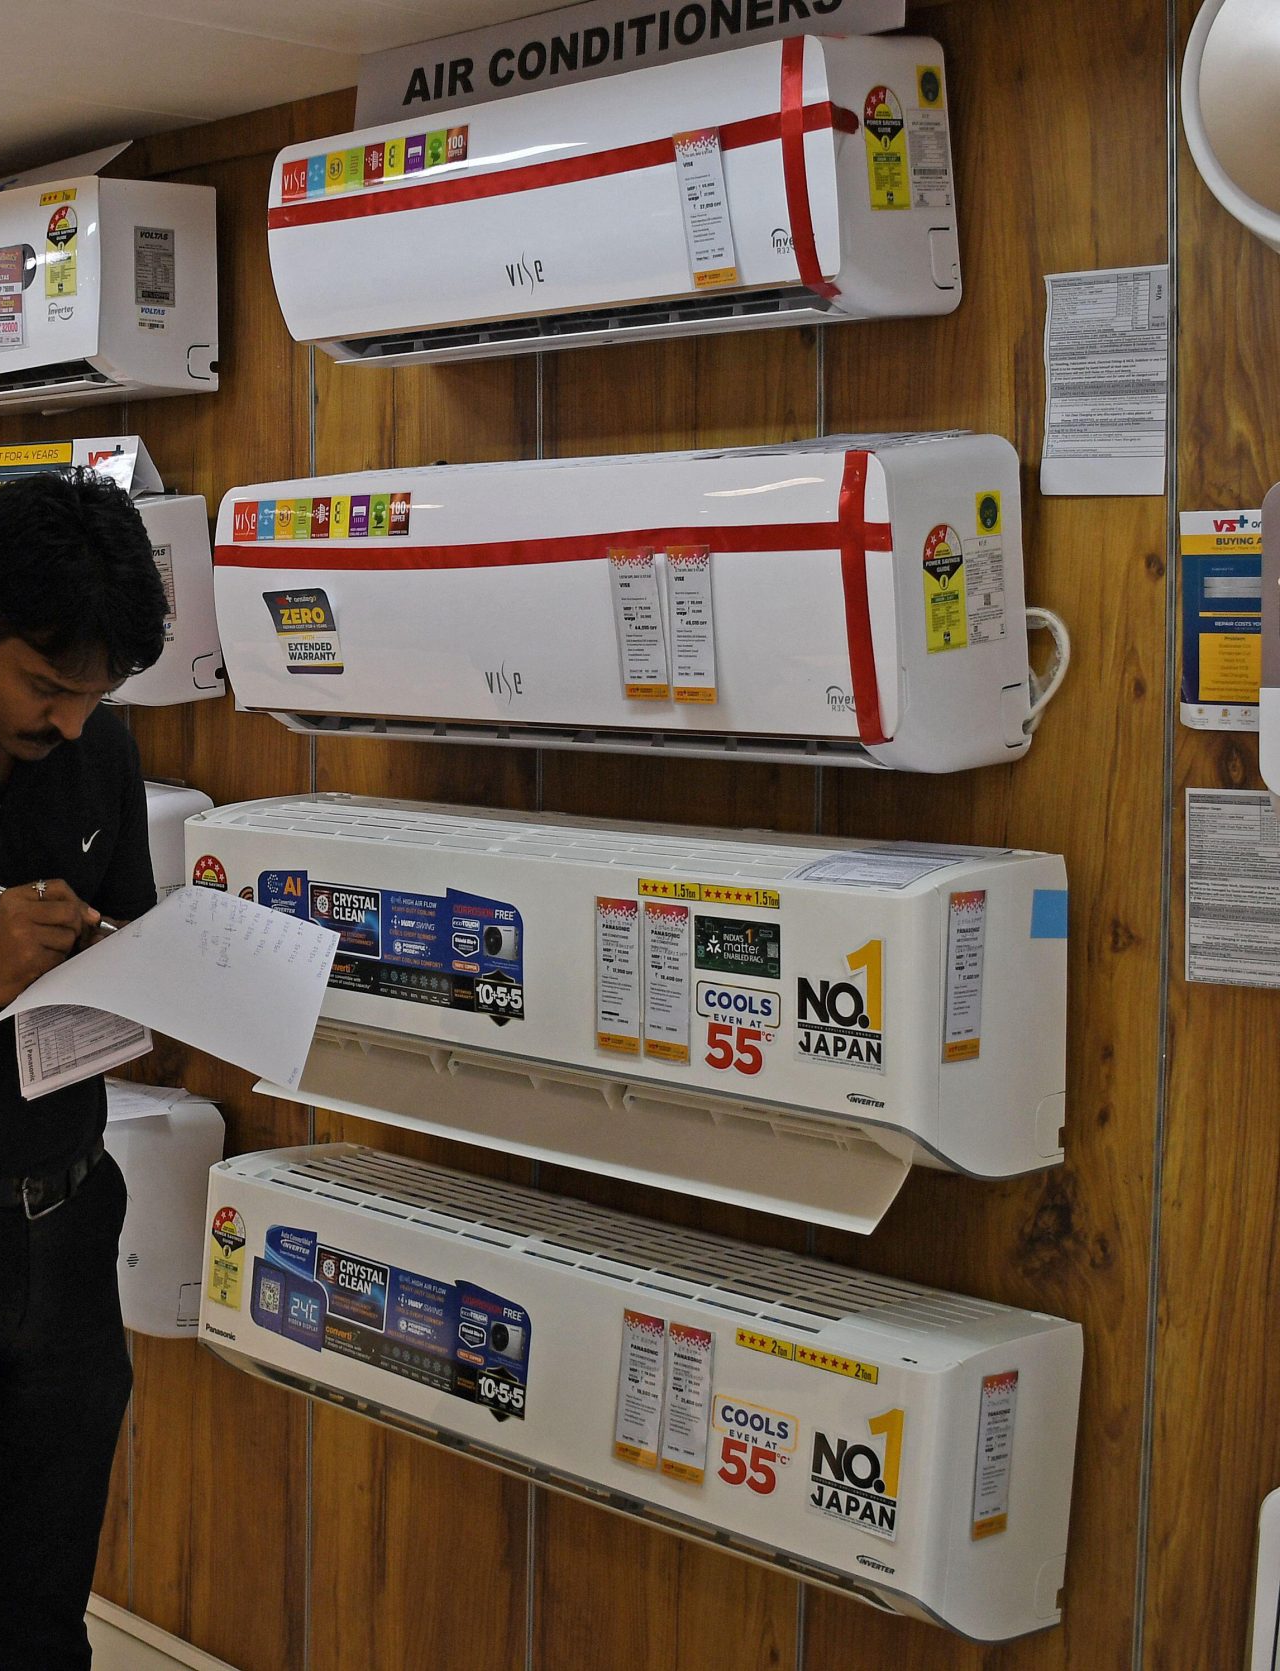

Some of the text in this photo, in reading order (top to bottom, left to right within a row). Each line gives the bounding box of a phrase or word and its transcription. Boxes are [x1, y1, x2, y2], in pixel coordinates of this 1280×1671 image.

[402, 58, 474, 106] AIR
[140, 231, 168, 240] VOLTAS
[141, 307, 166, 316] VOLTAS
[4, 451, 23, 461] FOR
[24, 451, 30, 460] 4
[32, 449, 59, 460] YEARS
[1216, 537, 1254, 546] BUYING
[280, 608, 325, 625] ZERO
[288, 643, 332, 652] EXTENDED
[289, 652, 336, 661] WARRANTY
[283, 876, 301, 897] AI
[333, 893, 377, 910] CRYSTAL
[423, 901, 437, 909] FLOW
[333, 907, 365, 923] CLEAN
[401, 919, 436, 931] WAY SWING
[602, 923, 630, 932] PANASONIC
[651, 929, 680, 939] PANASONIC
[723, 928, 753, 944] INDIA'S 1
[723, 942, 760, 955] matter
[723, 953, 764, 964] ENABLED RACs
[476, 983, 522, 1009] 10+5+5
[704, 989, 772, 1017] COOLS
[713, 1013, 763, 1030] EVEN AT
[798, 1032, 882, 1065] JAPAN
[849, 1094, 885, 1109] INVERTER
[281, 1231, 290, 1240] Auto
[282, 1241, 310, 1256] INVERTER
[340, 1259, 385, 1286] CRYSTAL
[338, 1273, 372, 1296] CLEAN
[423, 1283, 432, 1291] AIR
[433, 1285, 446, 1295] FLOW
[408, 1299, 443, 1316] WAY SWING
[205, 1323, 236, 1341] Panasonic
[288, 1317, 319, 1333] HIDDEN DISPLAY
[631, 1343, 658, 1356] PANASONIC
[674, 1351, 702, 1364] PANASONIC
[479, 1376, 524, 1408] 10+5+5
[721, 1405, 789, 1440] COOLS
[729, 1429, 778, 1450] EVEN AT
[811, 1485, 895, 1531] JAPAN
[858, 1557, 895, 1576] INVERTER
